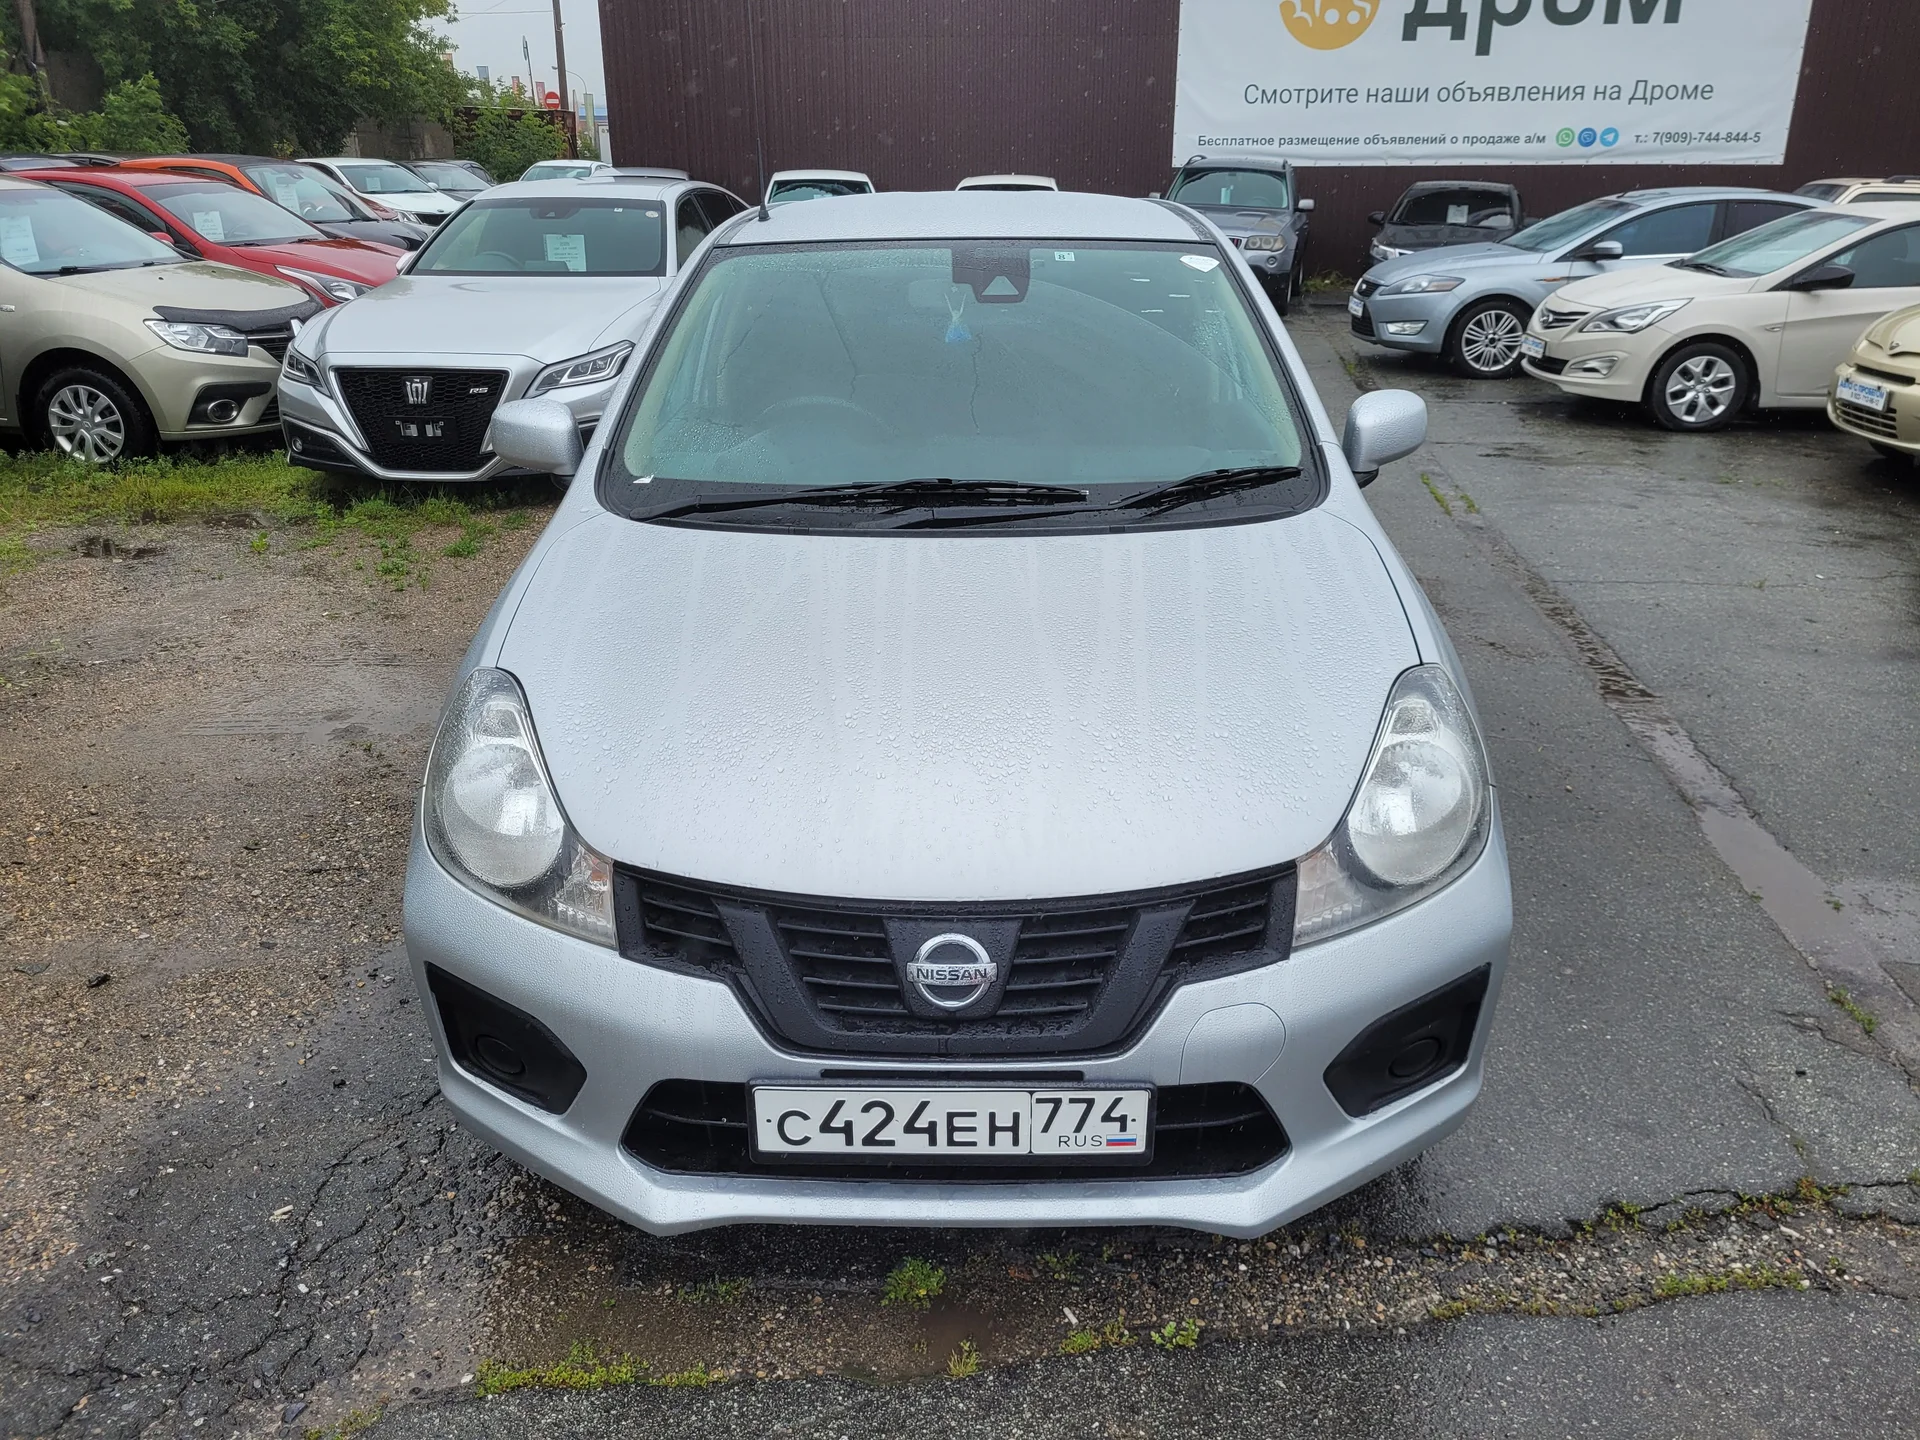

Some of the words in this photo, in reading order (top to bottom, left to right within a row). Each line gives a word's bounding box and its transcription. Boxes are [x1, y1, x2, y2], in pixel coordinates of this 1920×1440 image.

[1243, 83, 1359, 109] Смотрите
[1366, 86, 1430, 103] наши
[1436, 80, 1585, 103] объявления
[1592, 85, 1622, 101] на
[1627, 79, 1714, 106] Дроме
[1197, 135, 1275, 147] Бесплатное
[1278, 136, 1360, 149] размещение
[1363, 133, 1447, 146] объявлений
[1450, 136, 1458, 145] о
[1462, 134, 1521, 148] продаже
[1524, 132, 1546, 145] а/м
[1651, 131, 1762, 145] 7(909)-744-844-5
[916, 967, 988, 981] NISSAN
[1035, 1096, 1128, 1134] 774
[1058, 1135, 1103, 1148] RUS
